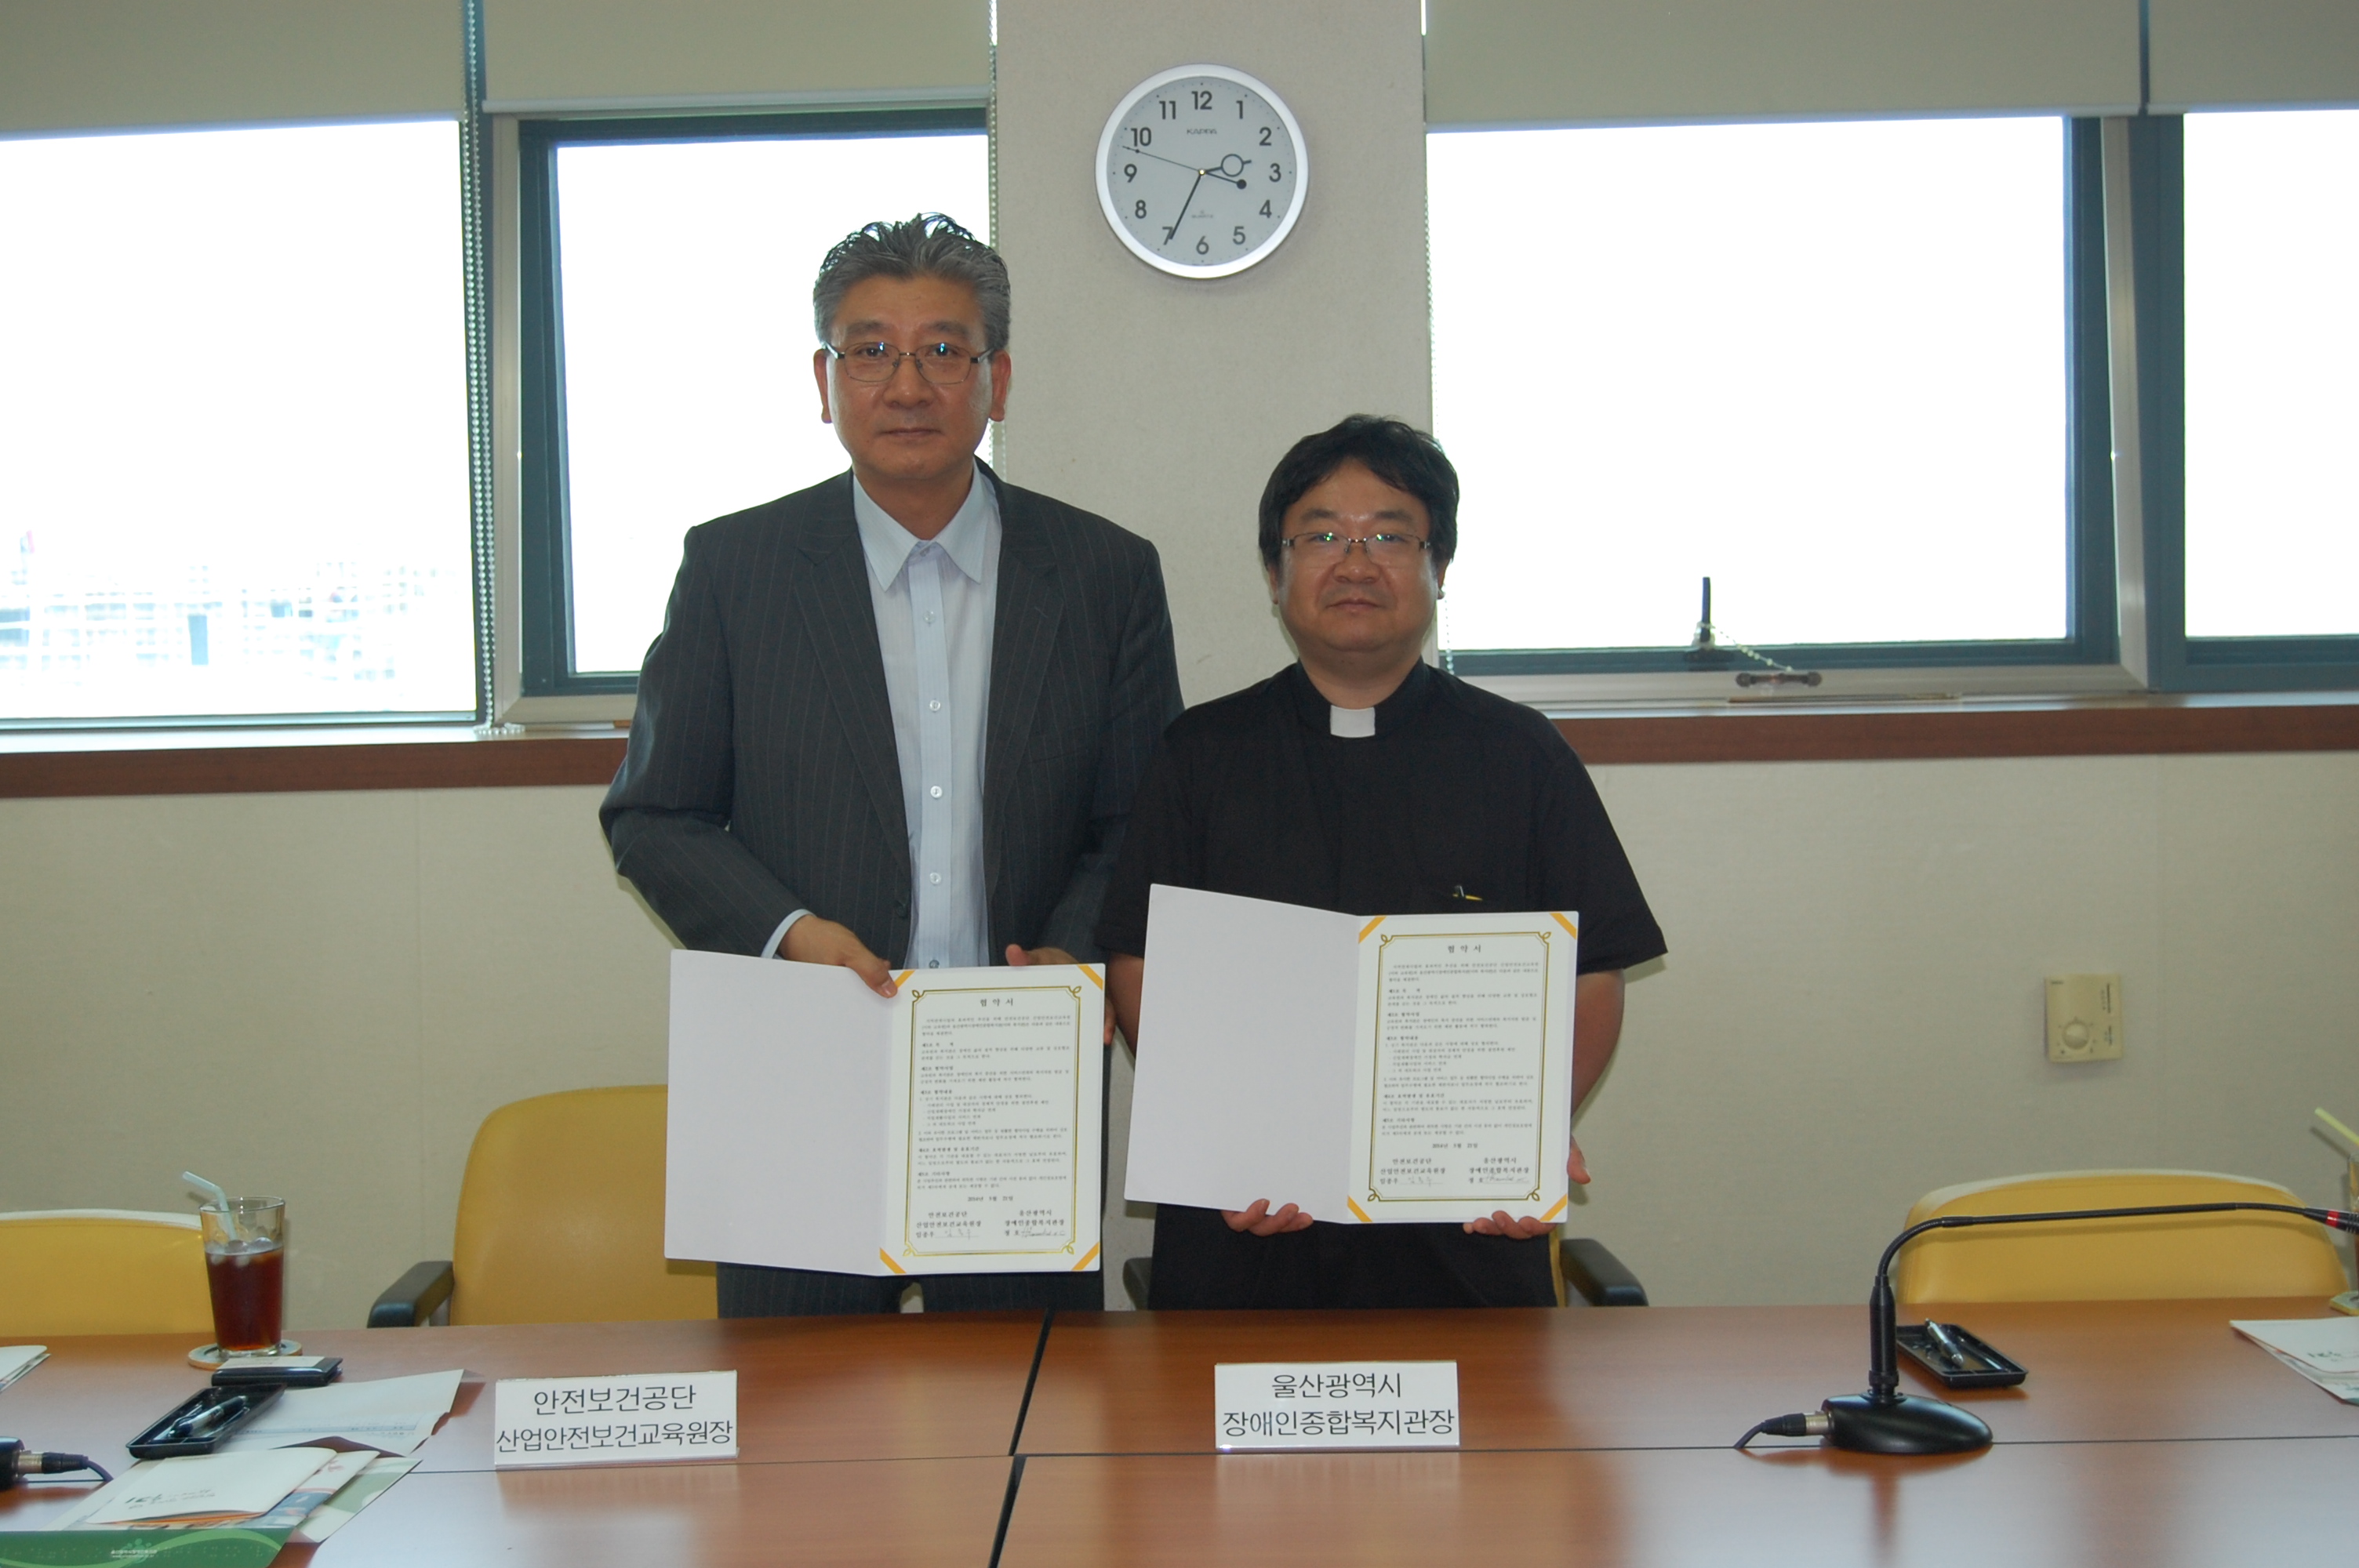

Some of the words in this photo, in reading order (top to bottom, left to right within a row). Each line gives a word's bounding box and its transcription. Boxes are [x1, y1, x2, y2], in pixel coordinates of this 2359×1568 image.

[1159, 100, 1176, 119] 11
[1191, 90, 1212, 110] 12
[1236, 100, 1244, 119] 1
[1130, 127, 1152, 147] 10
[1259, 127, 1272, 146] 2
[1124, 163, 1137, 183] 9
[1269, 163, 1281, 183] 3
[1135, 199, 1147, 220] 8
[1259, 199, 1272, 219] 4
[1161, 226, 1174, 245] 7
[1196, 236, 1209, 255] 6
[1232, 226, 1246, 245] 5
[1271, 1373, 1401, 1398] 울산광역시
[534, 1385, 696, 1415] 안전보건공단
[1223, 1409, 1455, 1437] 장애인종합복지관장
[496, 1420, 733, 1453] 산업안전보건교육원장
